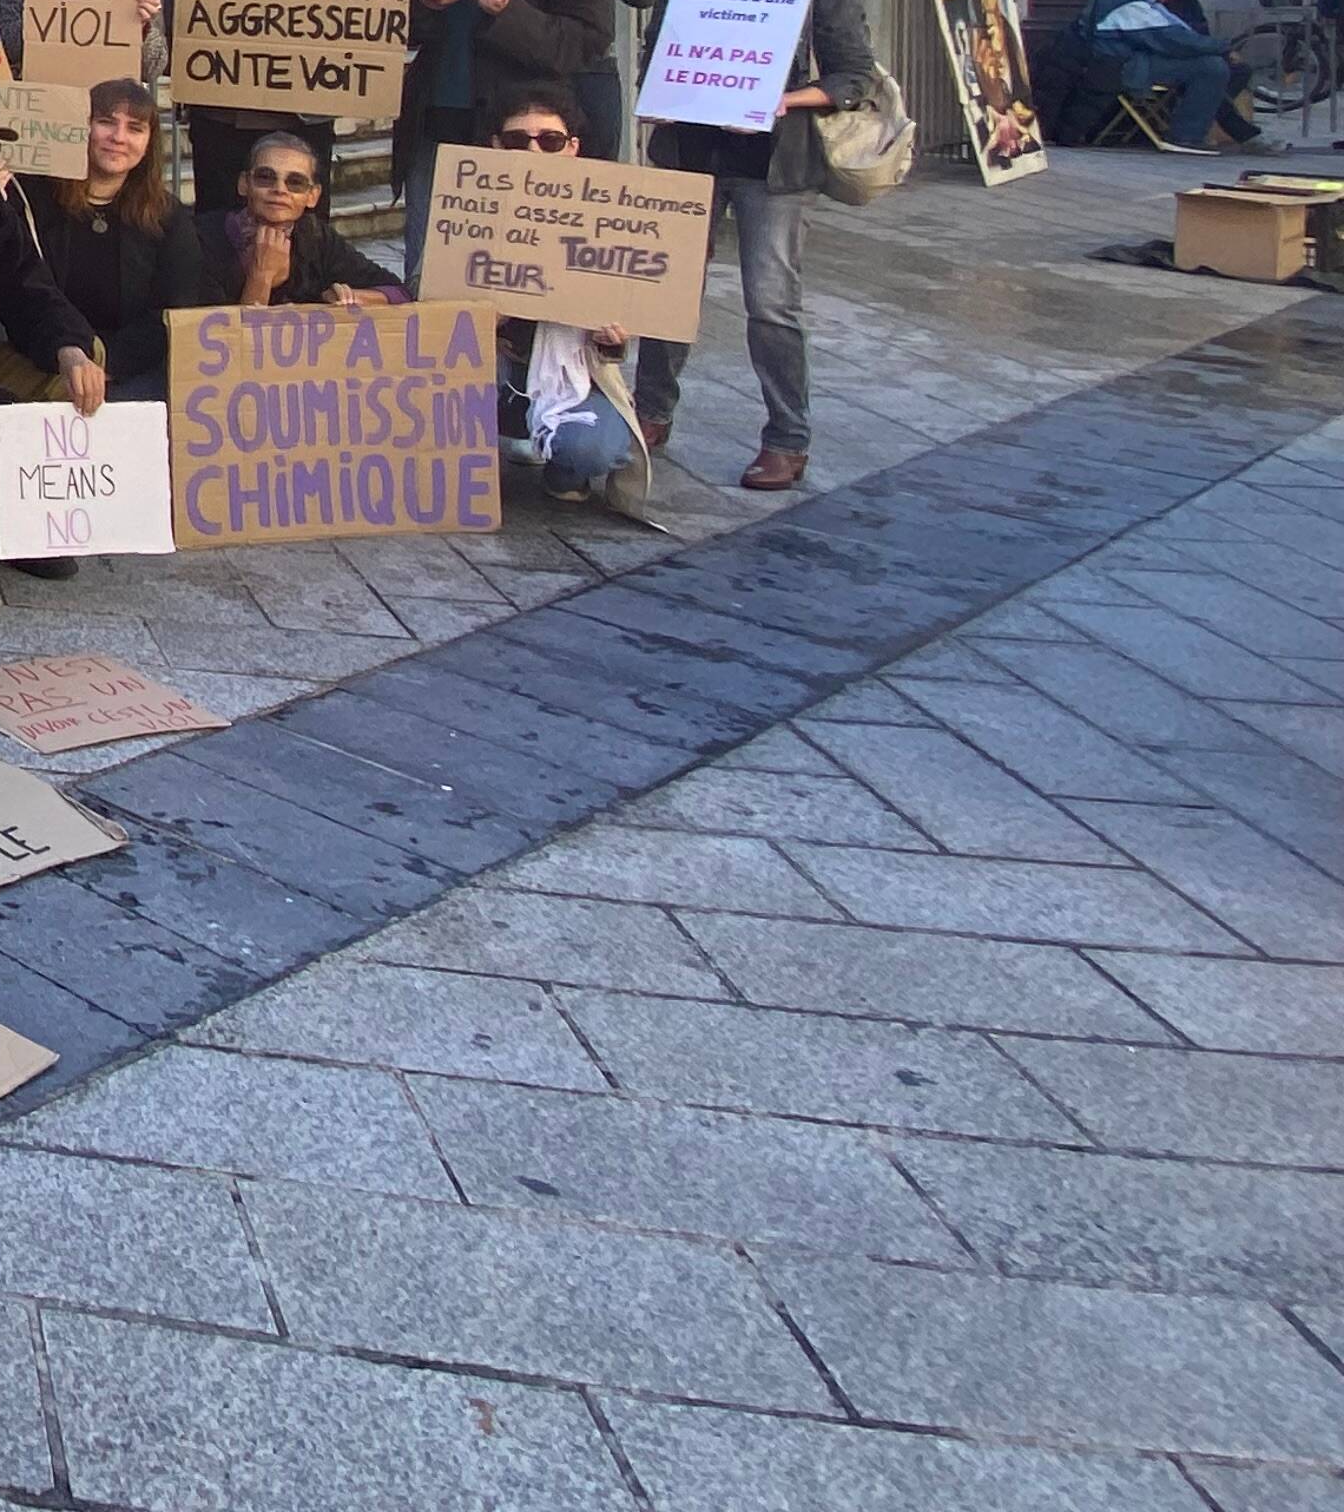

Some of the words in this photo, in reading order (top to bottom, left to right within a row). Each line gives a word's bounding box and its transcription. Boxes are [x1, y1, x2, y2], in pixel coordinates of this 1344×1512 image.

[29, 1, 131, 47] VIOL
[187, 0, 408, 44] AGGRESSEUR
[699, 8, 758, 23] victime
[667, 43, 683, 57] IL
[729, 48, 773, 65] PAS
[664, 68, 689, 84] LE
[692, 72, 761, 91] DROIT
[456, 159, 513, 190] Pas
[525, 170, 572, 198] tous
[580, 177, 611, 203] les
[618, 185, 707, 216] hommes
[436, 193, 499, 214] mais
[514, 204, 585, 228] assez
[198, 308, 336, 377] STOP
[345, 302, 384, 371] À
[406, 309, 484, 370] LA
[43, 415, 90, 458] NO
[19, 463, 116, 501] MEANS
[185, 451, 493, 536] CHIMIQUE
[46, 508, 92, 545] NO
[89, 675, 147, 697] UN
